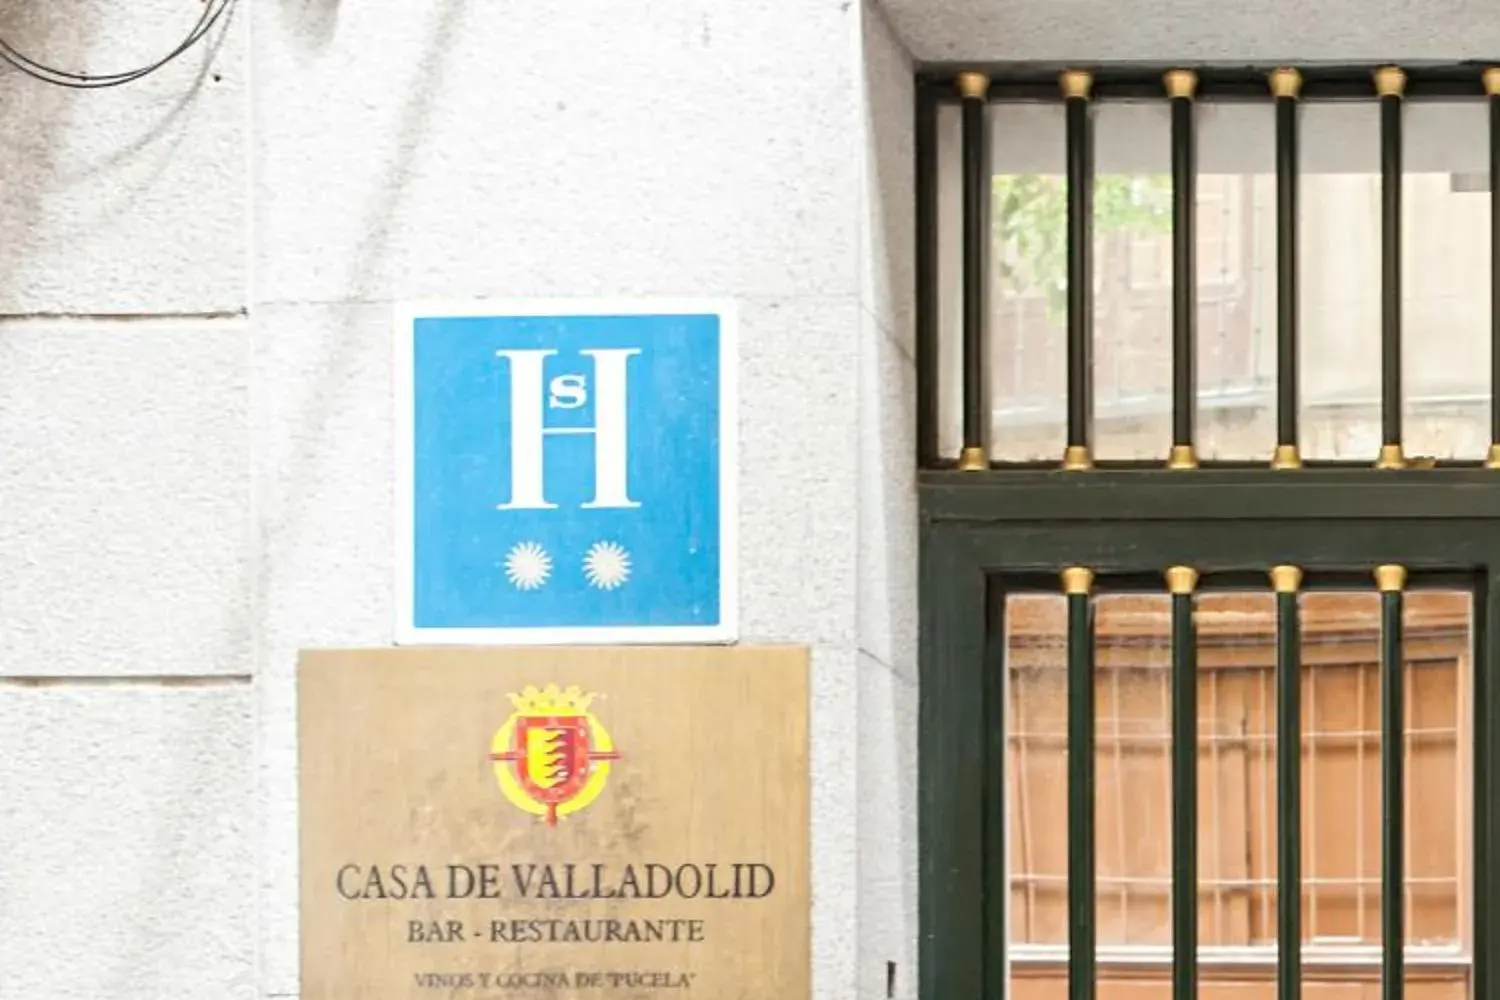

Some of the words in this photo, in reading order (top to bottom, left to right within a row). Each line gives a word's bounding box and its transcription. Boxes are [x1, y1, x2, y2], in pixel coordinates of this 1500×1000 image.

[336, 864, 436, 899] CASA
[447, 864, 500, 899] DE
[512, 863, 775, 899] VALLADOLID
[407, 919, 465, 943] BAR
[490, 918, 705, 943] RESTAURANTE
[414, 972, 475, 988] VINOS
[478, 972, 492, 988] Y
[496, 972, 570, 988] COCINA
[575, 972, 602, 988] DE
